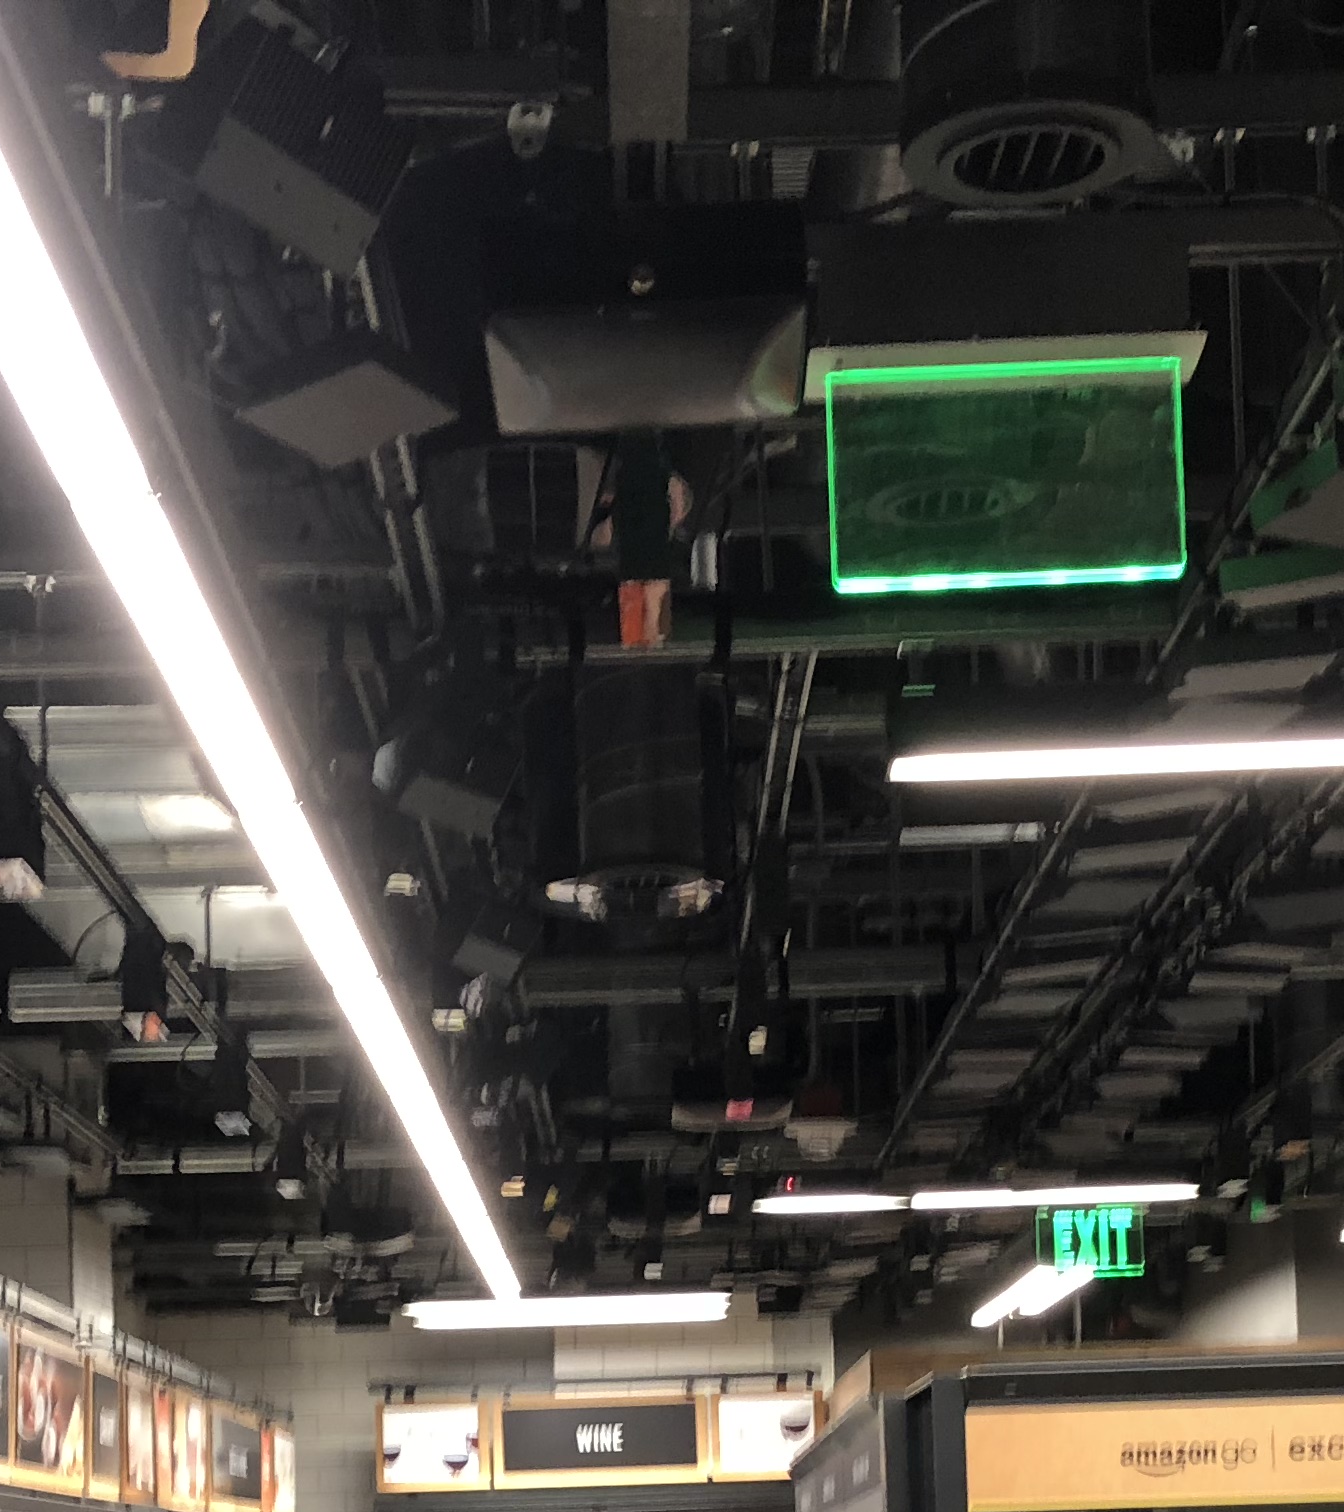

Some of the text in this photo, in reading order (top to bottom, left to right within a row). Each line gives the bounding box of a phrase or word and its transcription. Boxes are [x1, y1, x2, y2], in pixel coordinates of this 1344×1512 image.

[1053, 1208, 1133, 1272] EXIT
[576, 1422, 624, 1453] WINE
[1120, 1438, 1217, 1468] amazon
